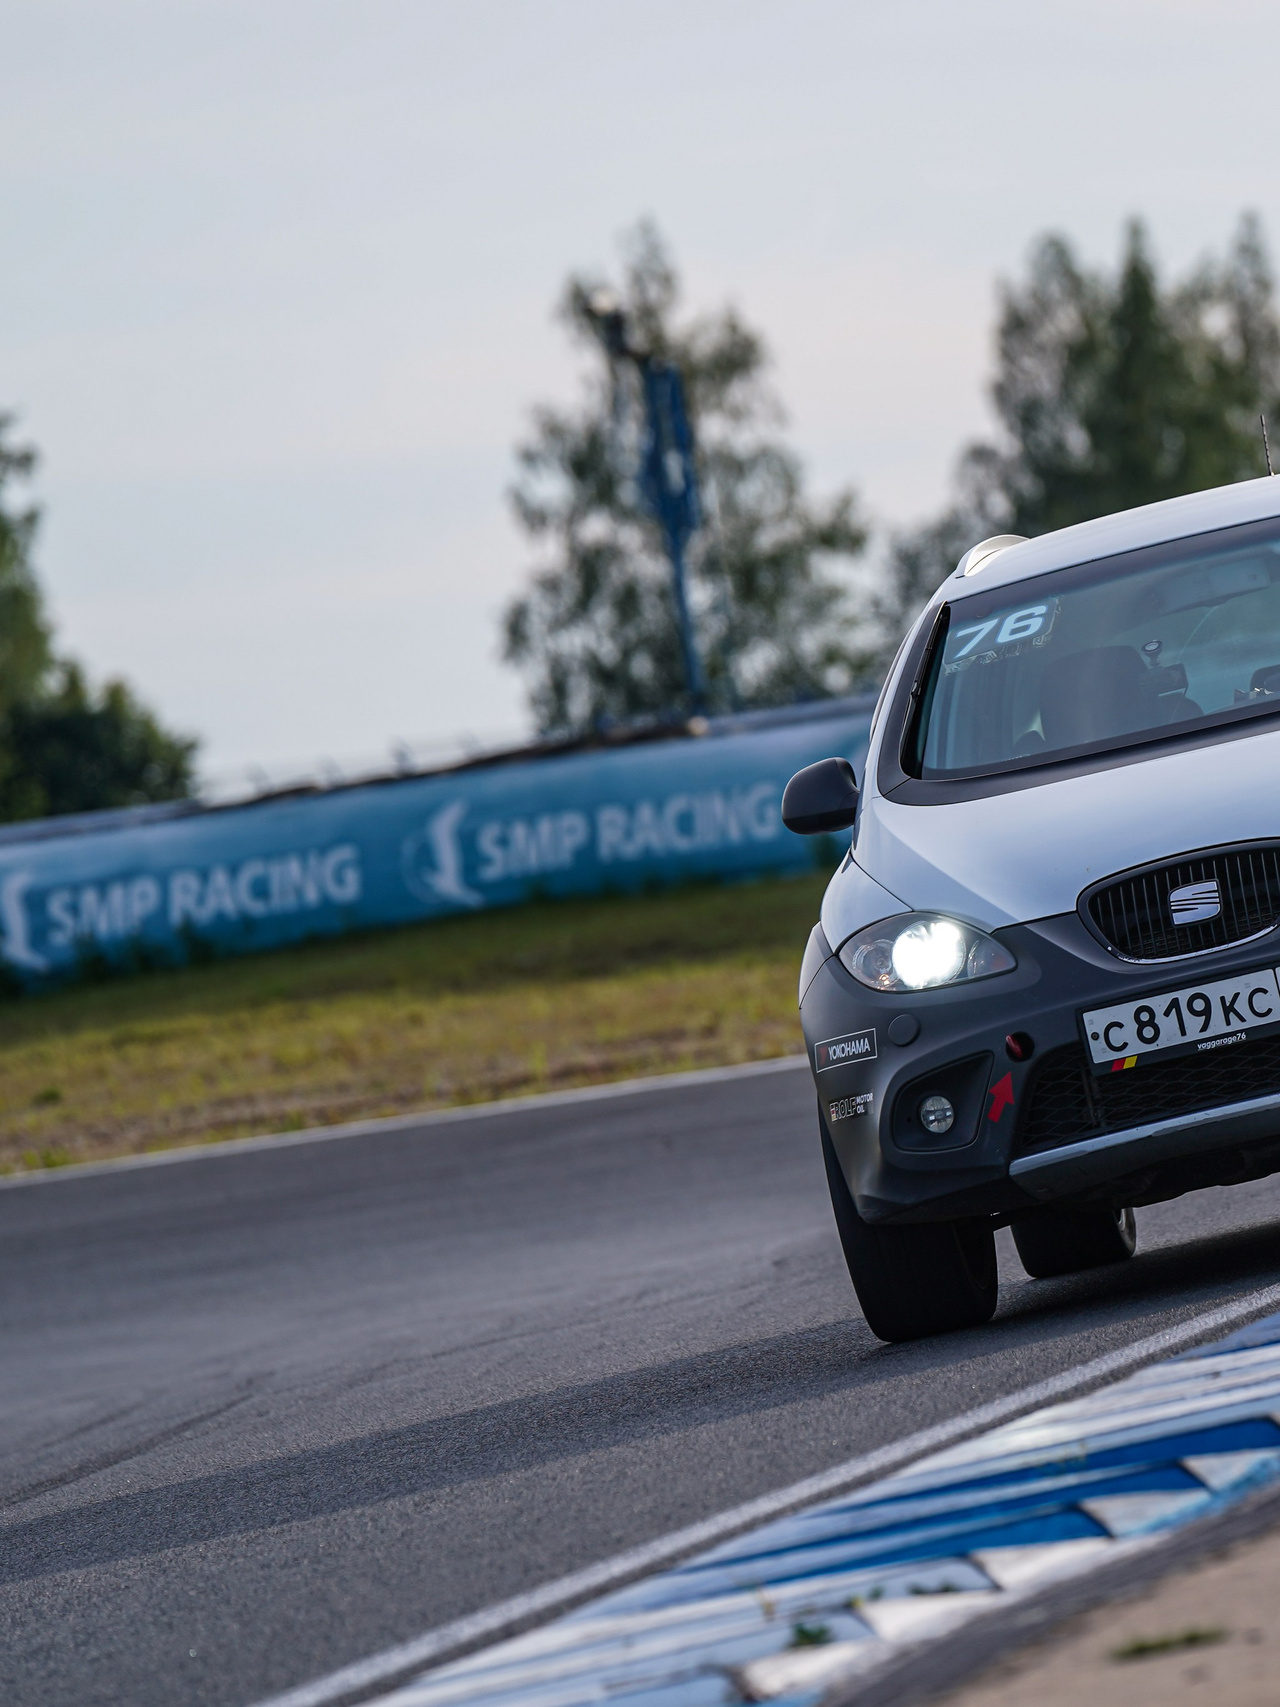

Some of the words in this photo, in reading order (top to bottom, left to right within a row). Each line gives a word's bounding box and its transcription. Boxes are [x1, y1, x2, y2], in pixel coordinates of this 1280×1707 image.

[953, 605, 1047, 660] 76
[477, 812, 590, 881] SMP
[596, 784, 780, 862] RACING
[47, 875, 160, 945] SMP
[167, 845, 361, 927] RACING
[828, 1037, 871, 1061] YOKOHAMA
[835, 1097, 857, 1119] ROLF
[856, 1092, 874, 1105] MOTOR
[856, 1105, 865, 1114] OIL
